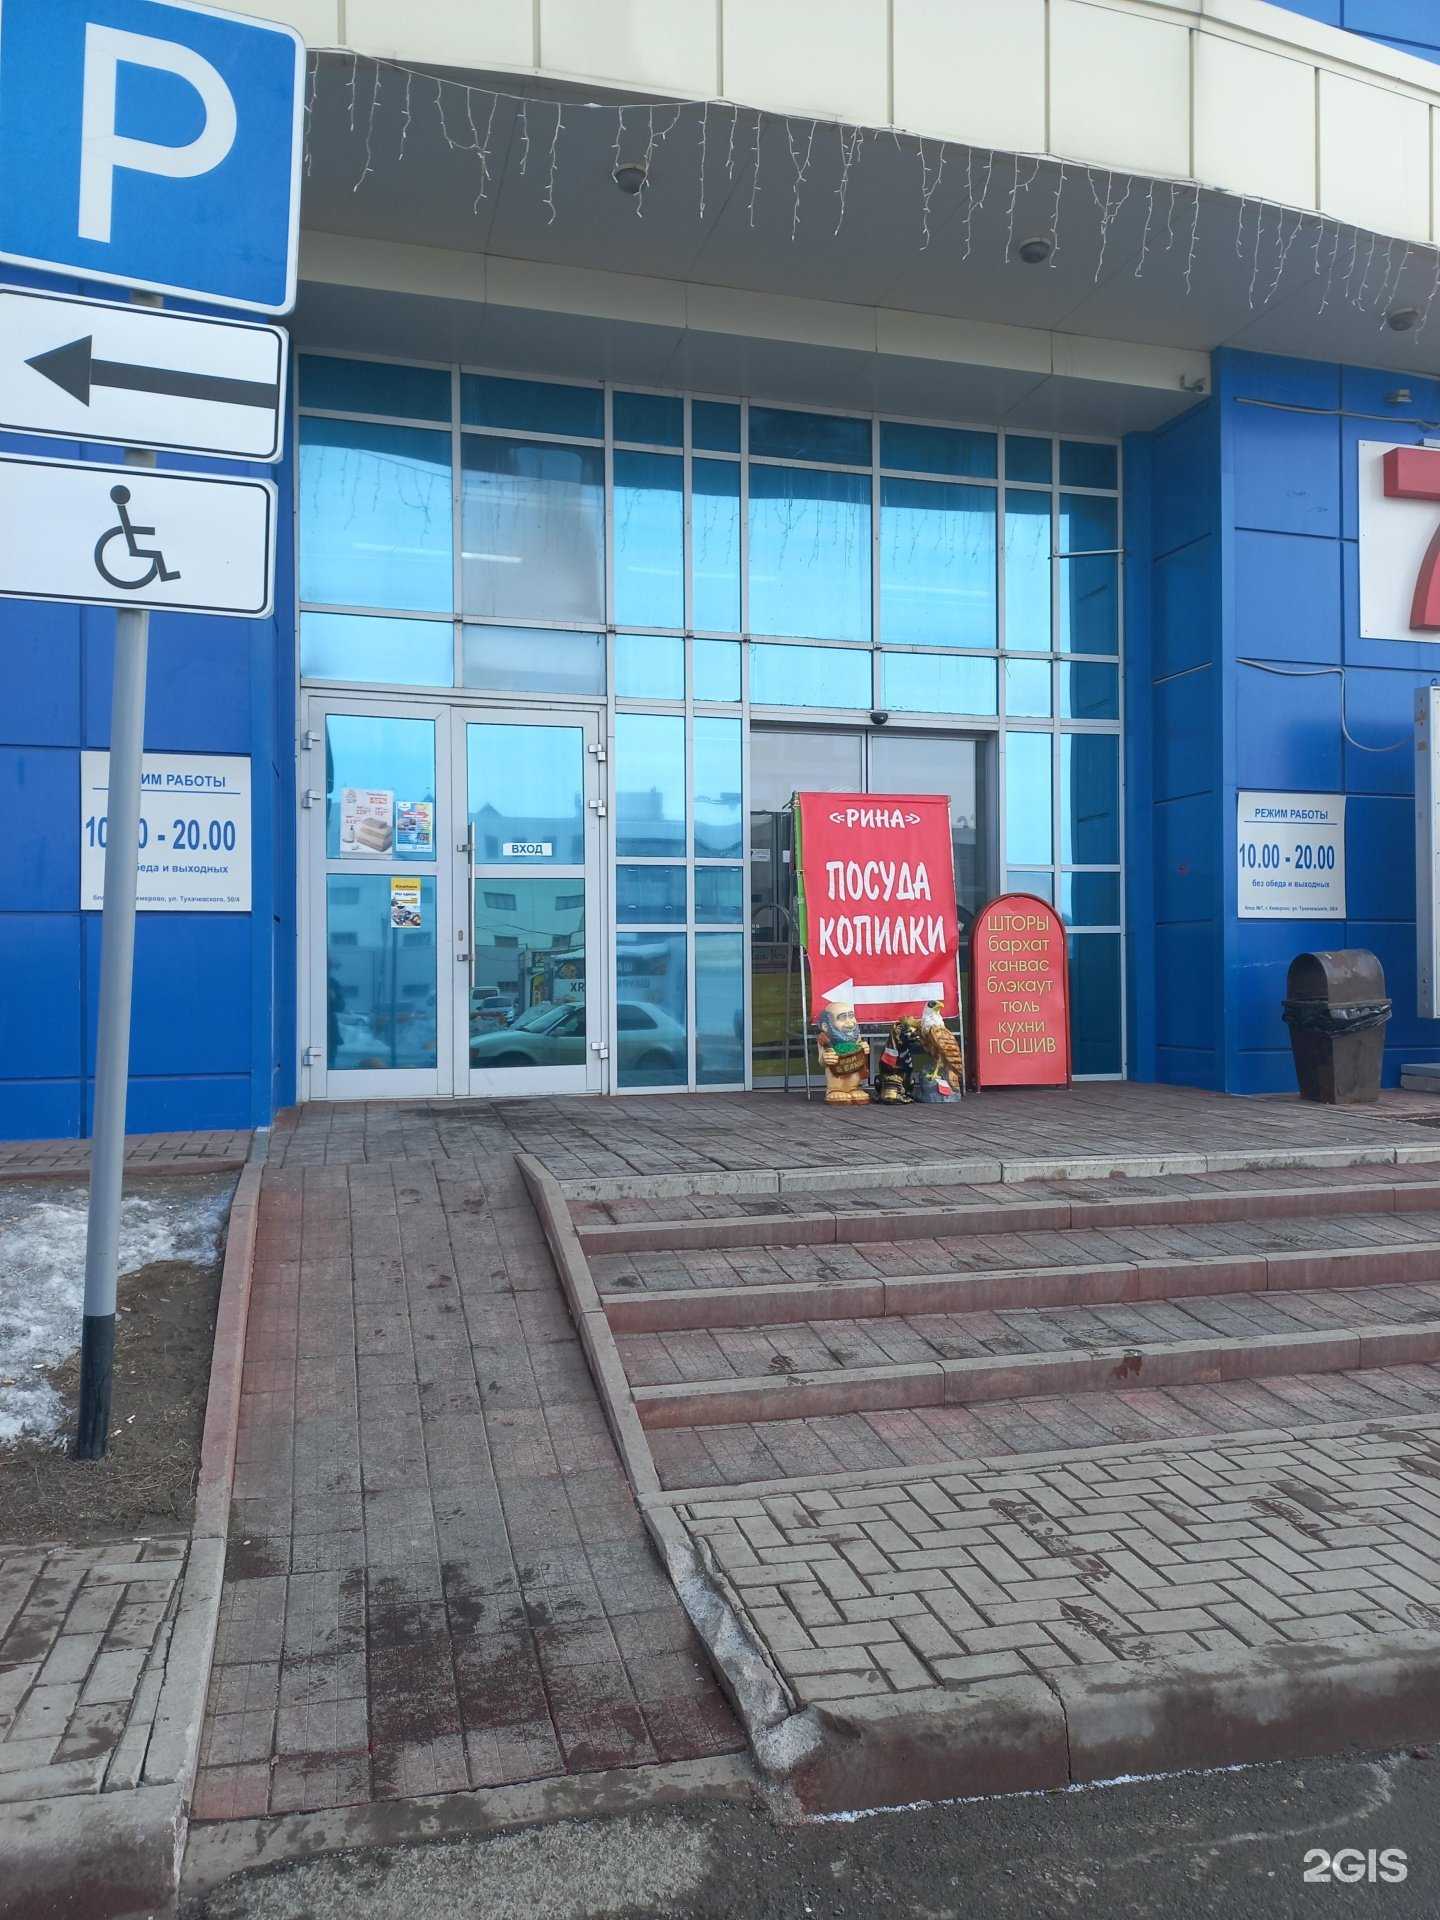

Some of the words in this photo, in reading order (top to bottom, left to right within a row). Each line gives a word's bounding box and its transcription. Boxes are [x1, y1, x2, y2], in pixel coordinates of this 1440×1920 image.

[166, 774, 226, 788] РАБОТЫ
[1254, 808, 1288, 818] РЕЖИМ
[1290, 809, 1329, 820] РАБОТЫ
[85, 816, 148, 849] 100
[172, 819, 236, 851] 20.00
[511, 844, 544, 856] ВХОД
[1239, 843, 1280, 869] 10.00
[1295, 844, 1335, 870] 20.00
[162, 865, 169, 873] и
[172, 866, 229, 874] выходных
[826, 860, 932, 902] ПОСУДА
[1252, 879, 1264, 887] без
[1265, 880, 1287, 888] обеда
[1294, 881, 1330, 889] выходных
[987, 915, 1049, 933] ШТОРЫ
[818, 914, 947, 958] КОПИЛКИ
[987, 936, 1050, 956] бархат
[988, 960, 1049, 973] канвас
[987, 977, 1053, 995] блэкаут
[1001, 999, 1040, 1013] тюль
[998, 1021, 1045, 1037] кухни
[988, 1037, 1057, 1055] ПОШИВ
